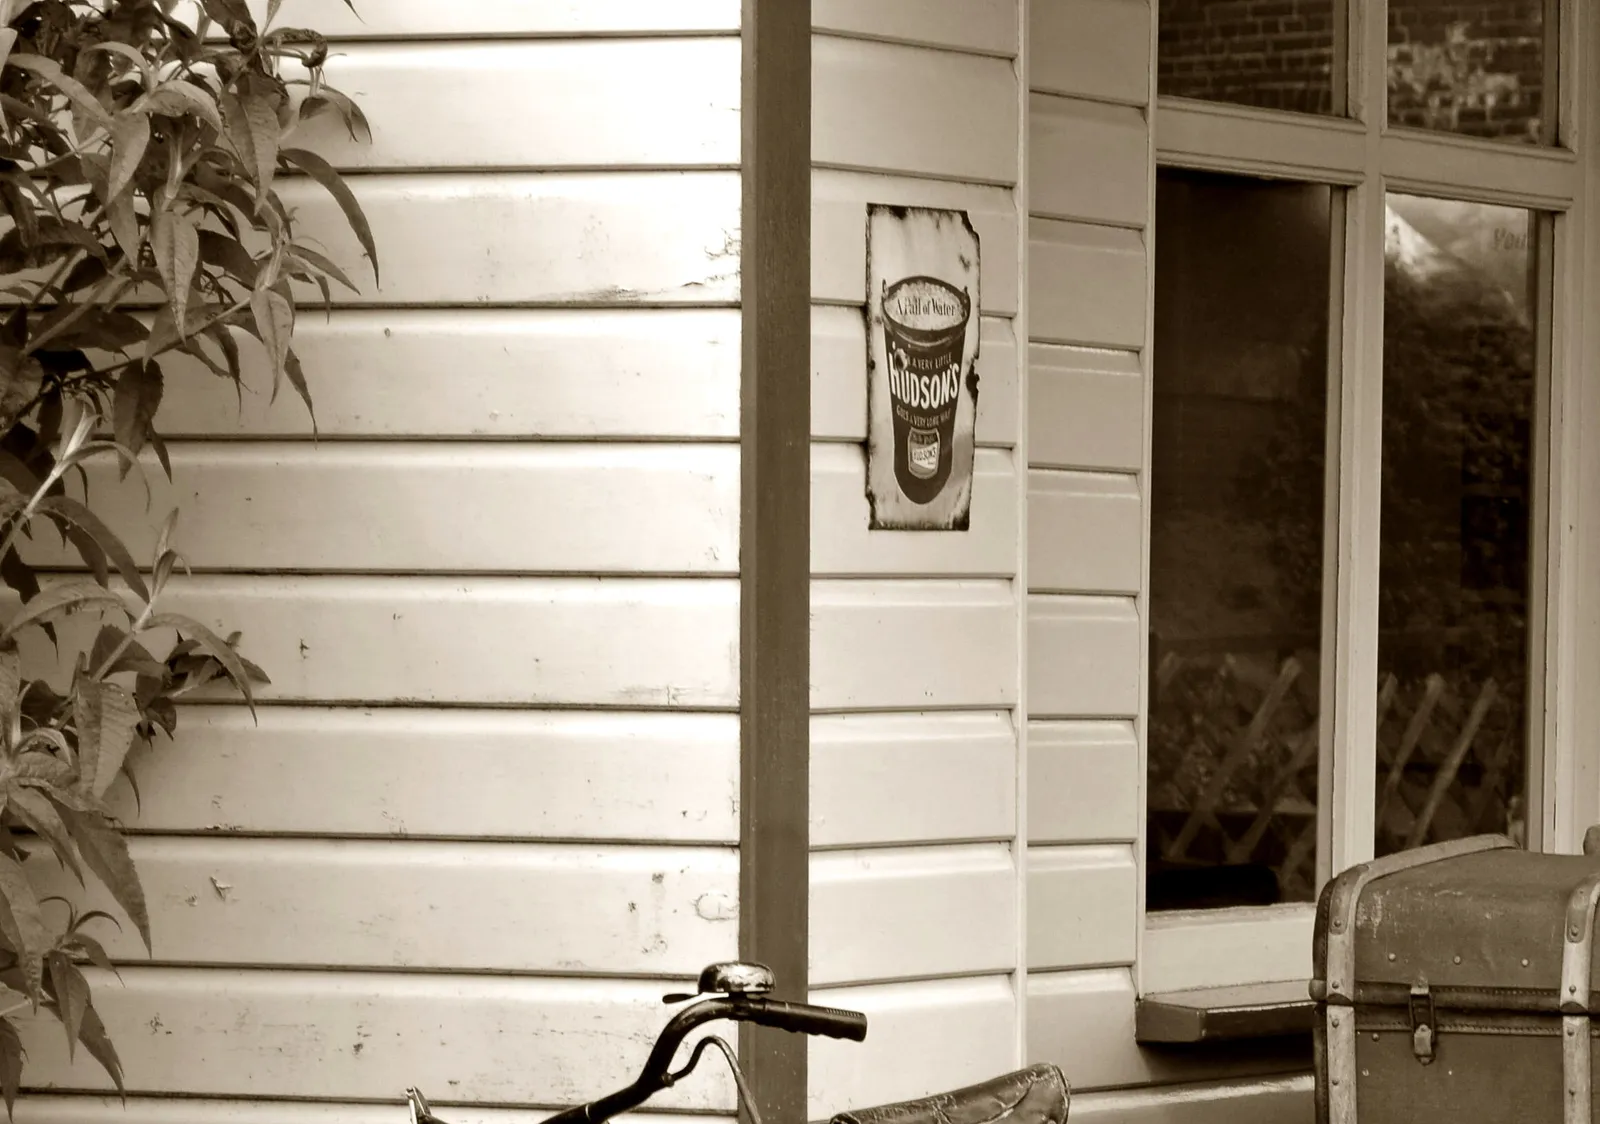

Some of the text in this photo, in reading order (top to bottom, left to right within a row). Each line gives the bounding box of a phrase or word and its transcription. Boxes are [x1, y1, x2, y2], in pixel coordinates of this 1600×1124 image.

[922, 300, 931, 316] of
[931, 297, 955, 317] Water
[917, 358, 933, 370] VERY
[934, 351, 952, 369] LITTLE
[888, 351, 960, 409] HUDSON'S
